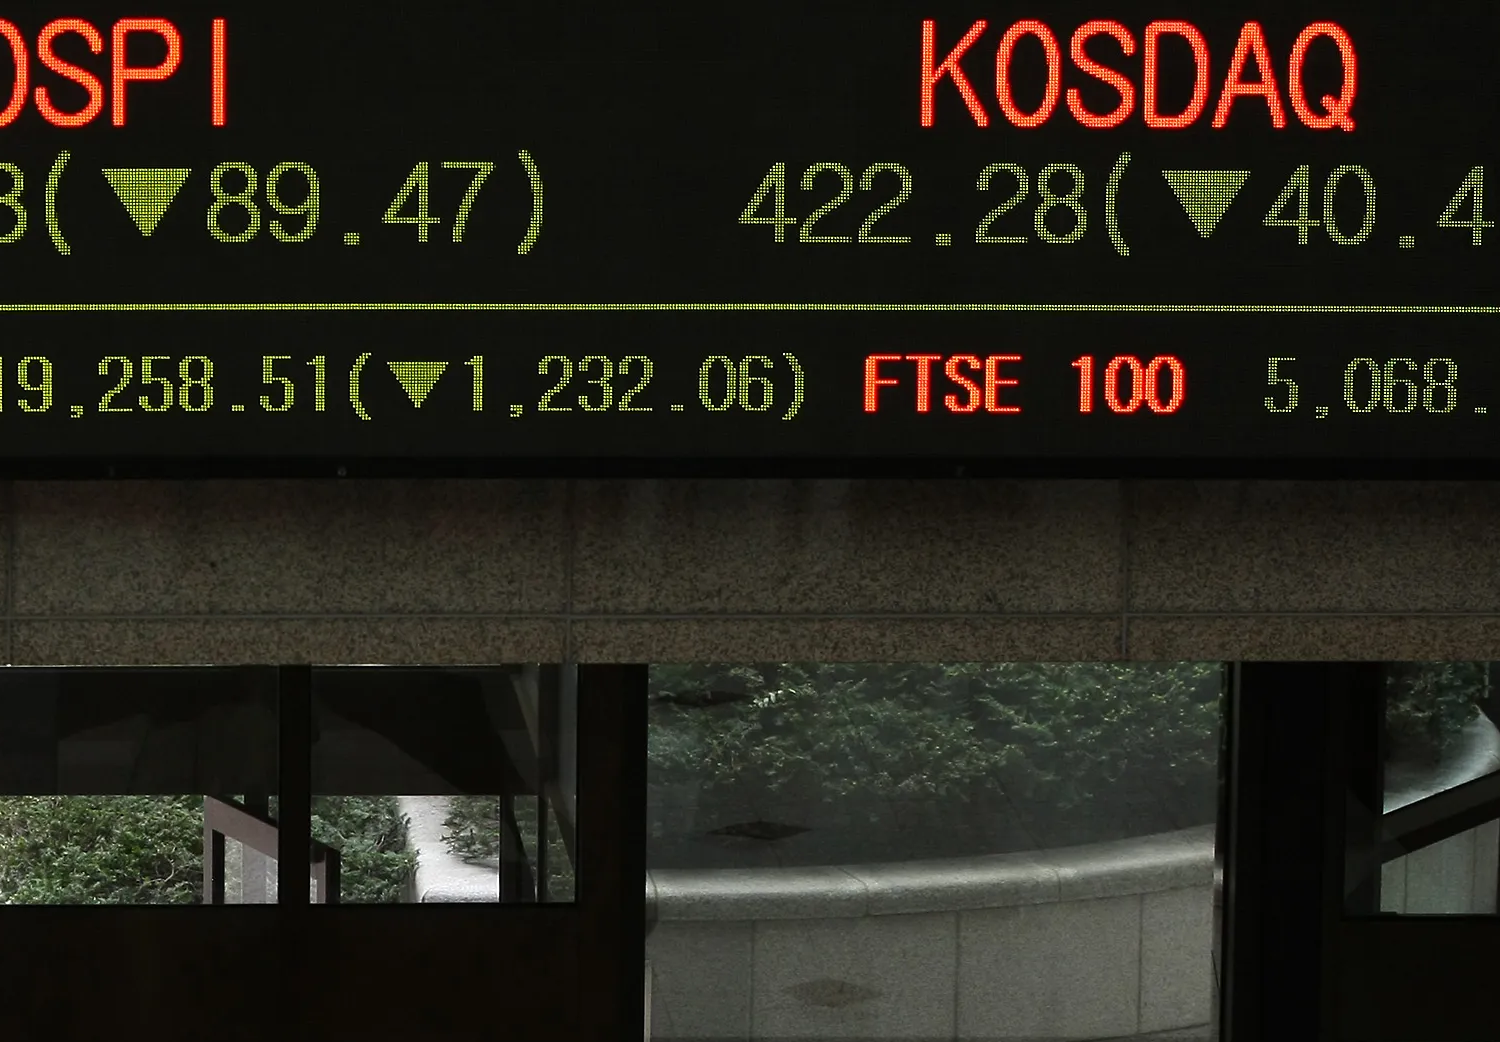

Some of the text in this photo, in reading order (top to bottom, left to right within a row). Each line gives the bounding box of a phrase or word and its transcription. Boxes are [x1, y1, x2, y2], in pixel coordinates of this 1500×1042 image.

[920, 18, 1358, 132] KOSDAQ
[863, 353, 1023, 414] FTSE
[1071, 354, 1186, 415] 100
